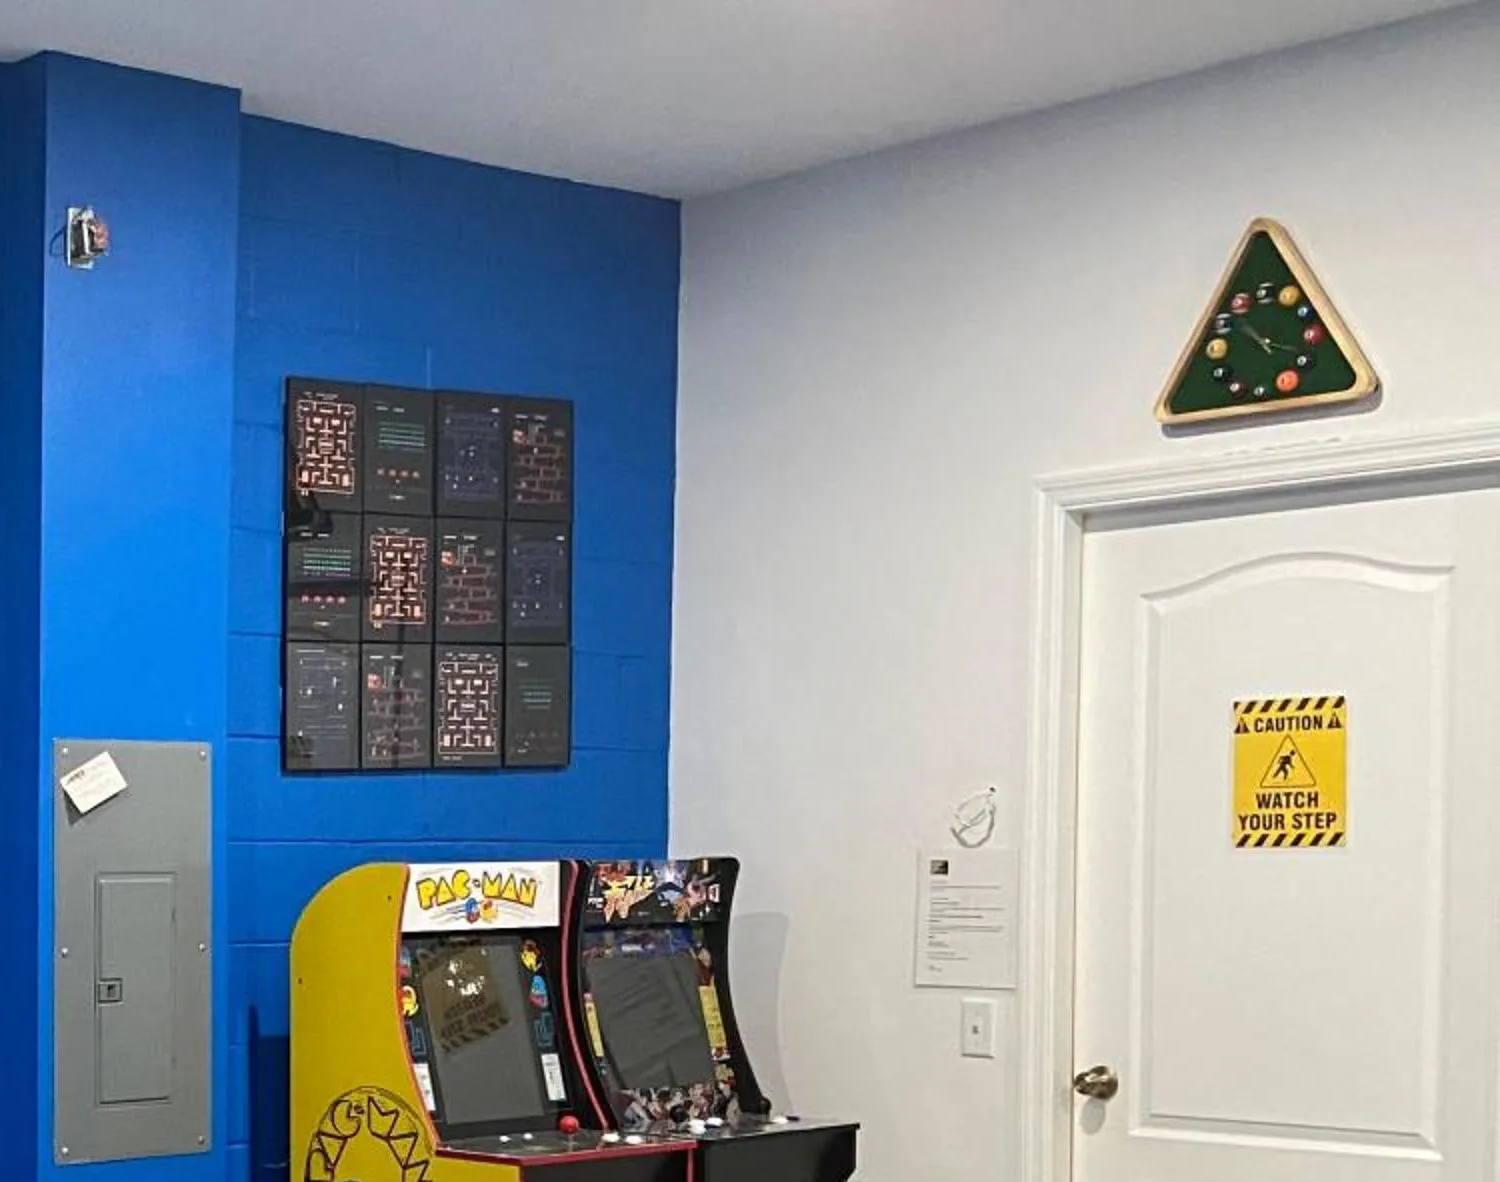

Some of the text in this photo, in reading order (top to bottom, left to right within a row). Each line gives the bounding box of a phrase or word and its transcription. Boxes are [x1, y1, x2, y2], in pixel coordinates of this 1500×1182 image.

[1254, 715, 1323, 733] CAUTION
[1256, 791, 1319, 809] WATCH
[1238, 812, 1337, 831] YOUR STEP
[416, 869, 538, 910] PAC-MAN
